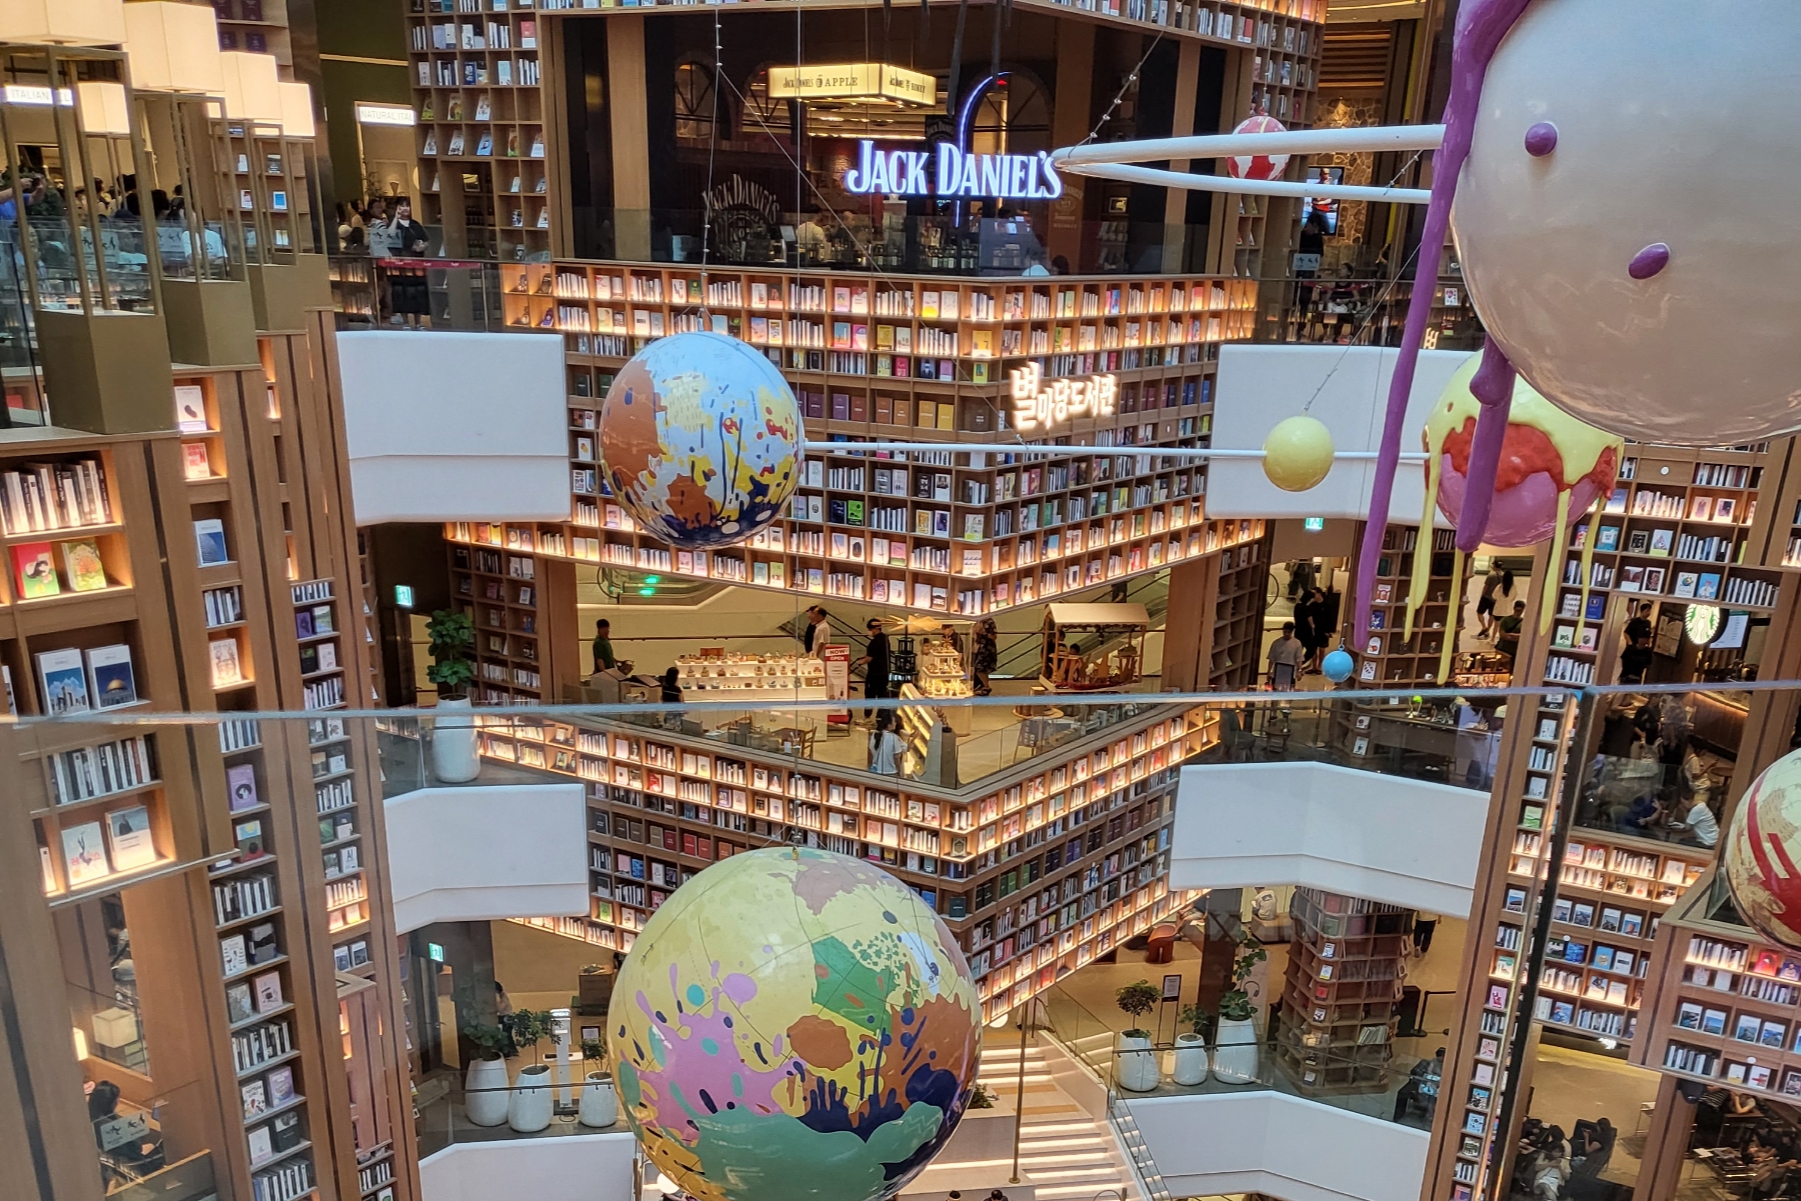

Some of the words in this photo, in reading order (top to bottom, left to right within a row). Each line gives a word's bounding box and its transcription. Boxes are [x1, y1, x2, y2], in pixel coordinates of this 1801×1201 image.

[824, 76, 859, 87] APPLE
[11, 89, 50, 101] ITALIAN
[361, 109, 396, 121] NATURAL
[845, 140, 930, 194] JACK
[937, 142, 1063, 199] DANIEL'S
[1010, 361, 1117, 430] 별마당도서관
